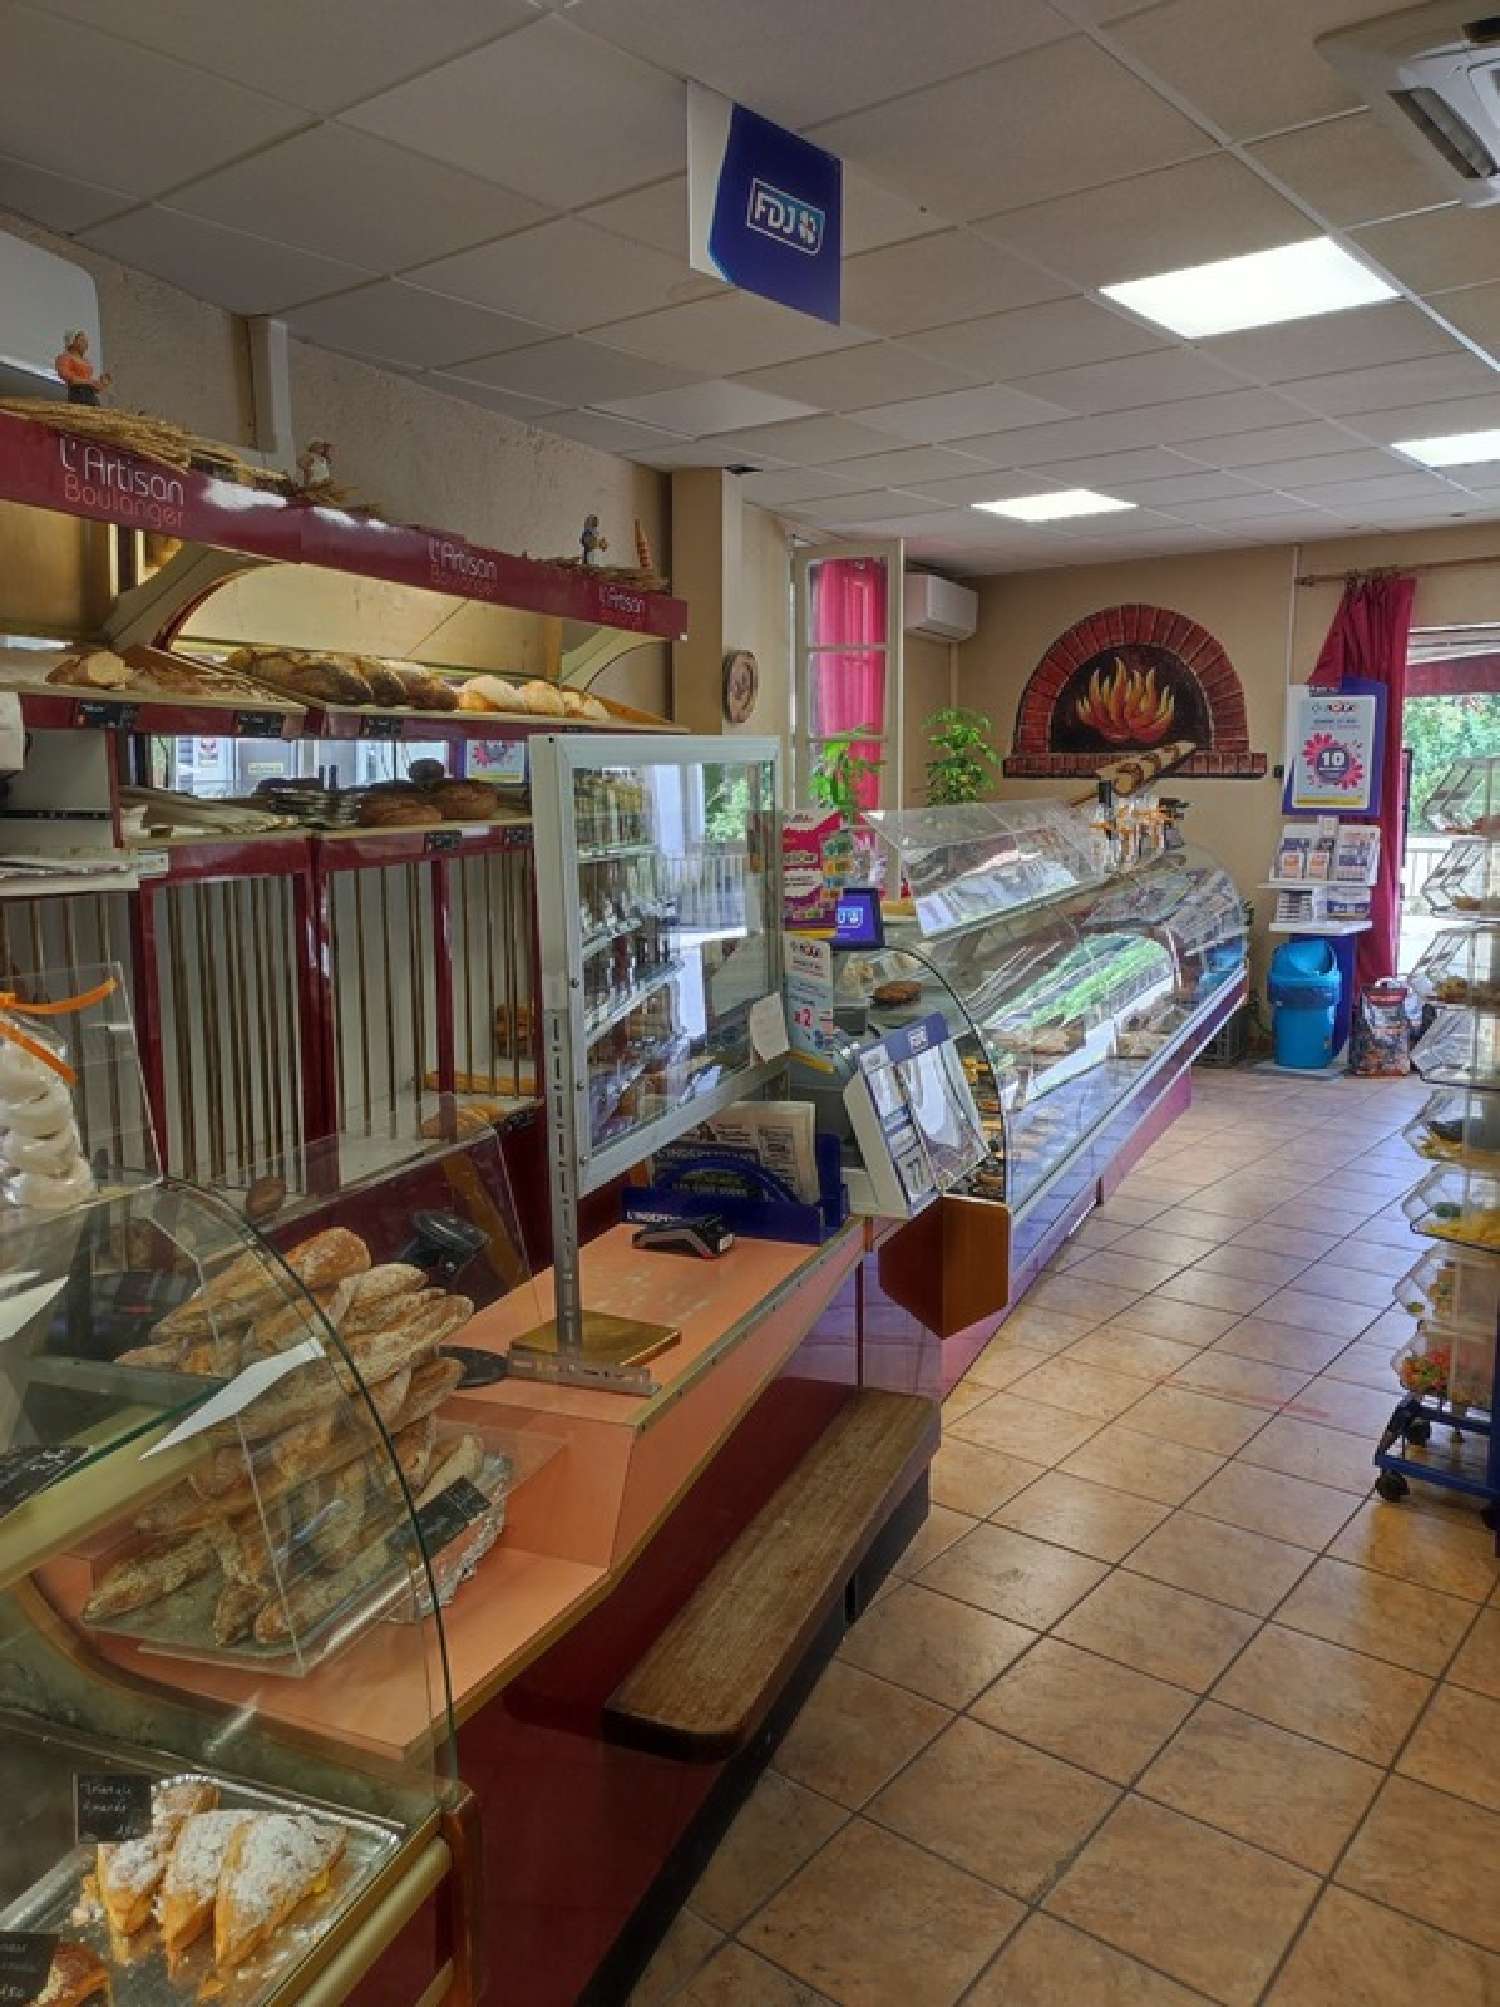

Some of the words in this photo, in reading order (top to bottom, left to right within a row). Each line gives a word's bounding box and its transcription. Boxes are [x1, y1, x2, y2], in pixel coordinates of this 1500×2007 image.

[755, 192, 795, 234] FDJ
[65, 474, 184, 529] Boulanger
[1322, 752, 1345, 766] 10
